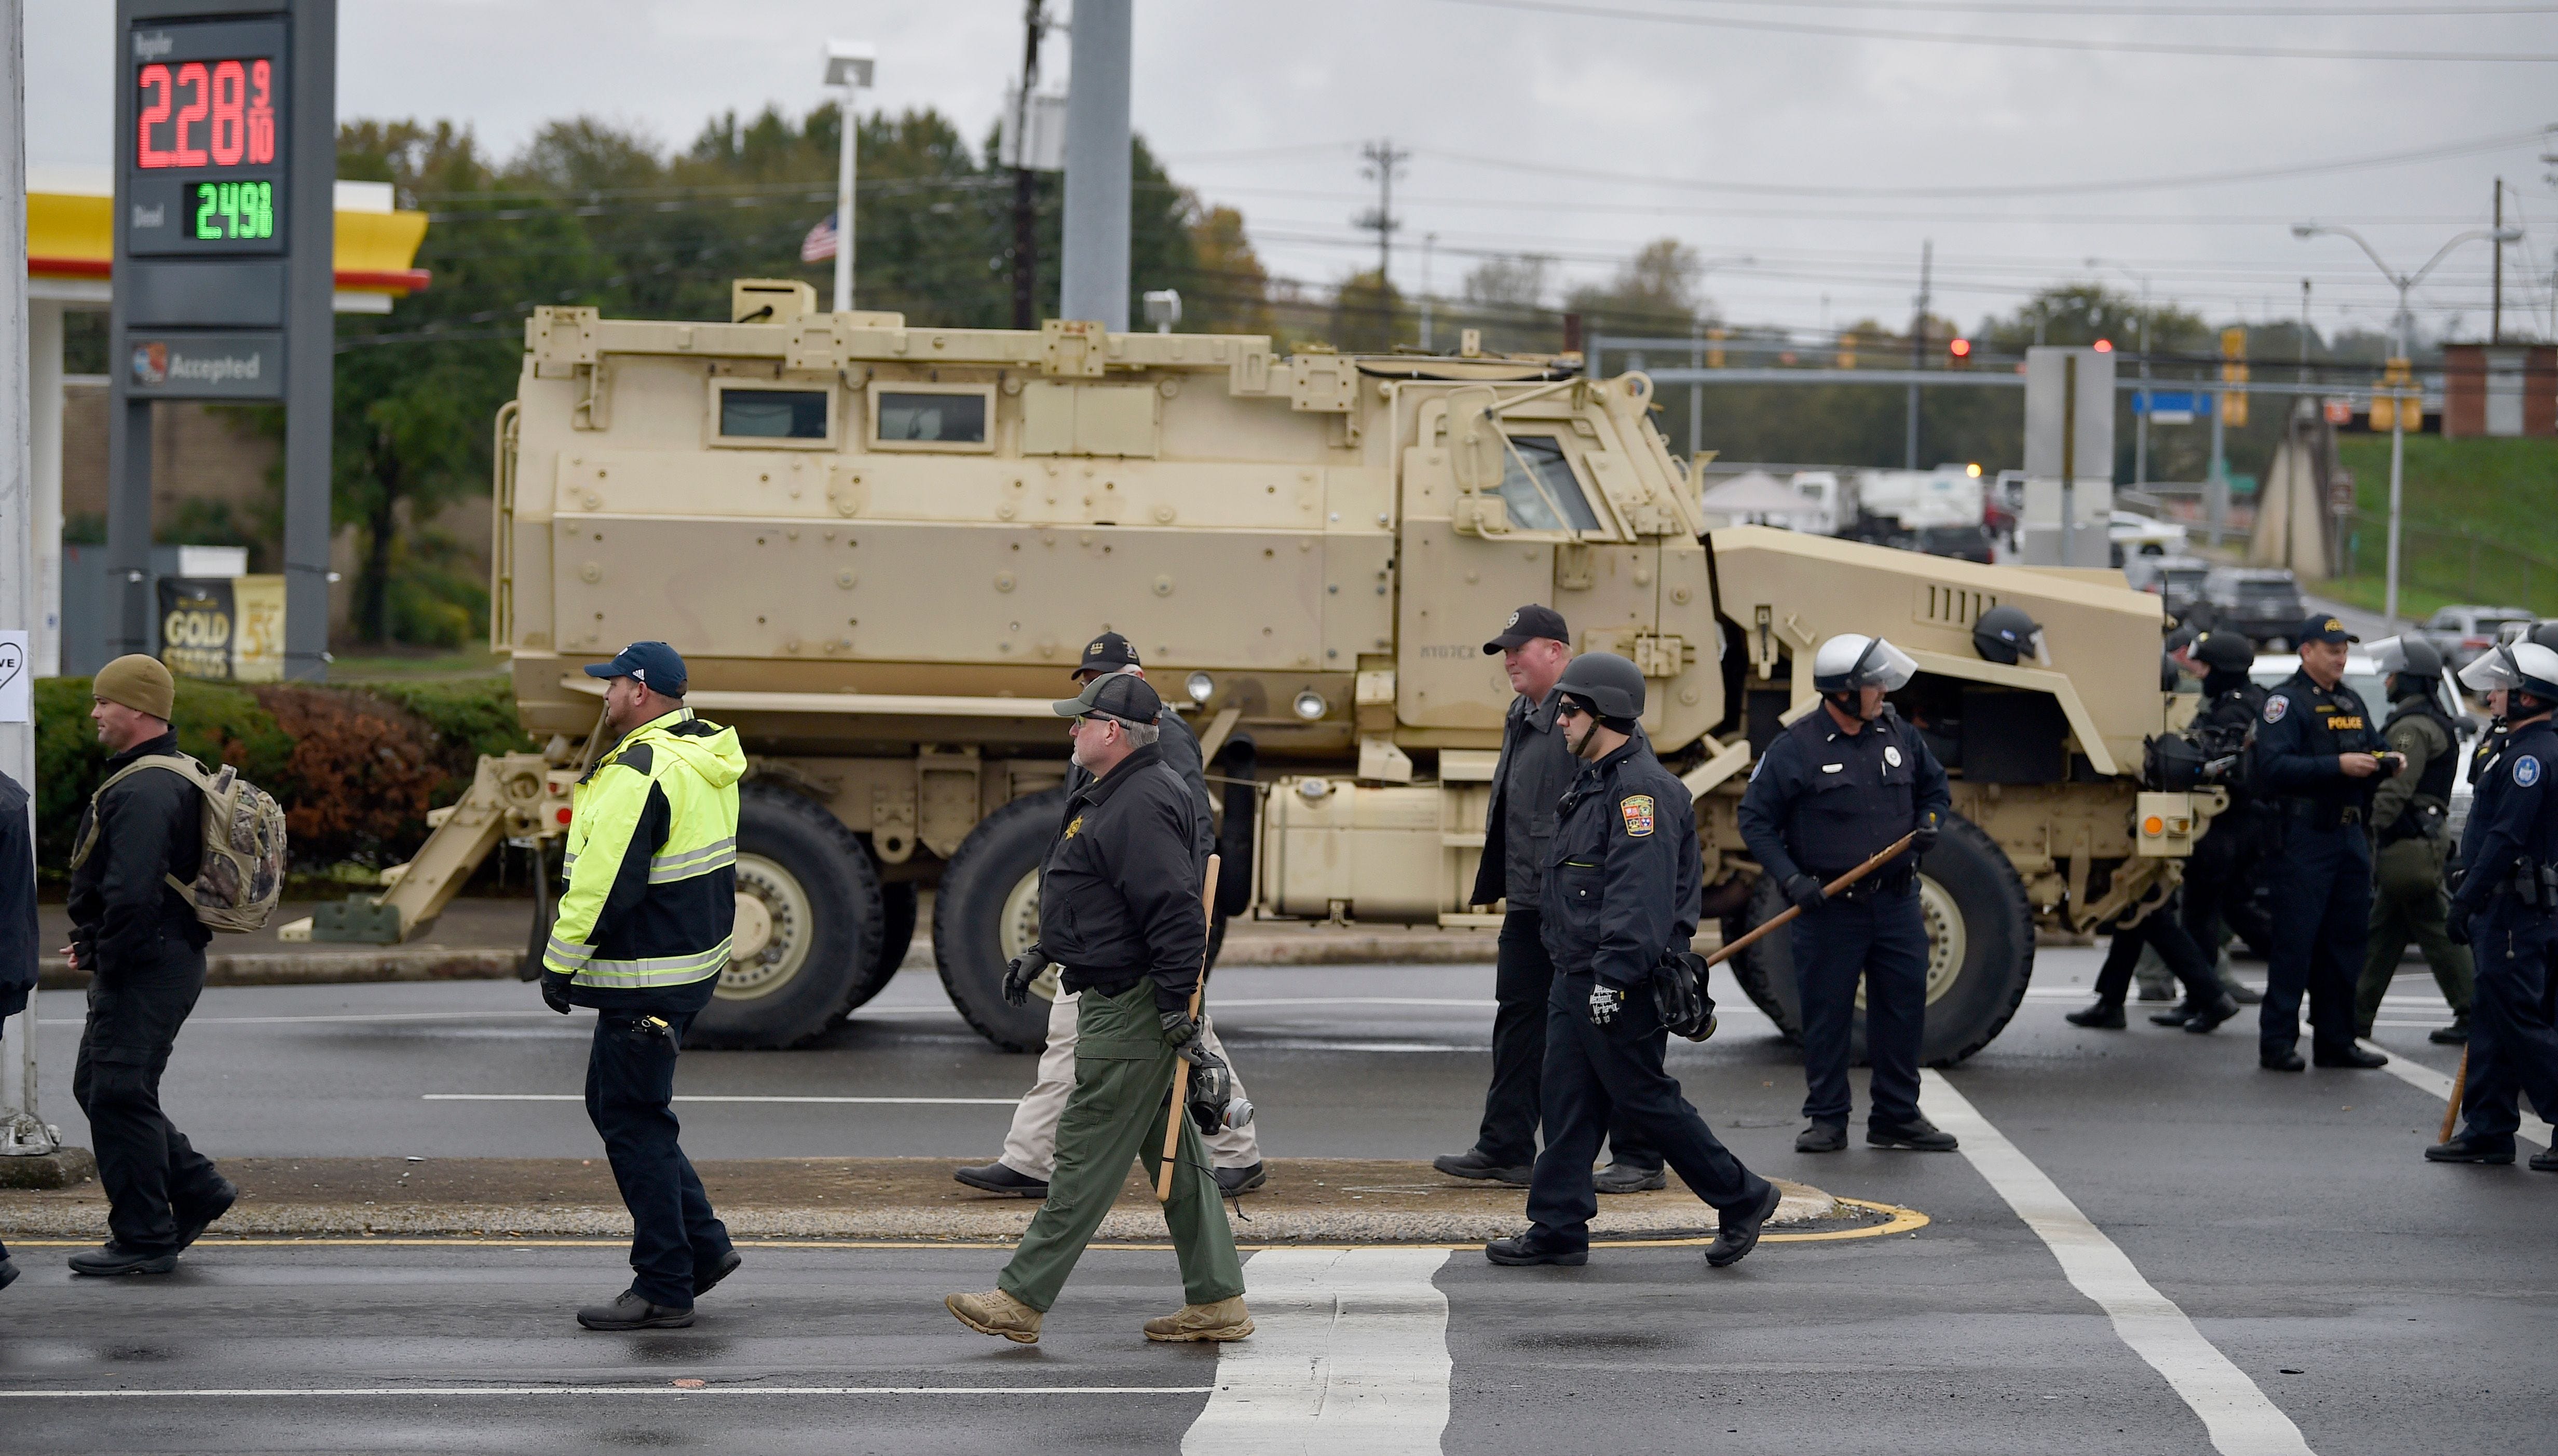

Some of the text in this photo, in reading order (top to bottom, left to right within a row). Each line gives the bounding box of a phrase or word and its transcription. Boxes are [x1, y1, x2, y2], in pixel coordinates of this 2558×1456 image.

[169, 352, 260, 384] Accepted
[165, 610, 230, 647] GOLD
[2328, 716, 2363, 730] POLICE
